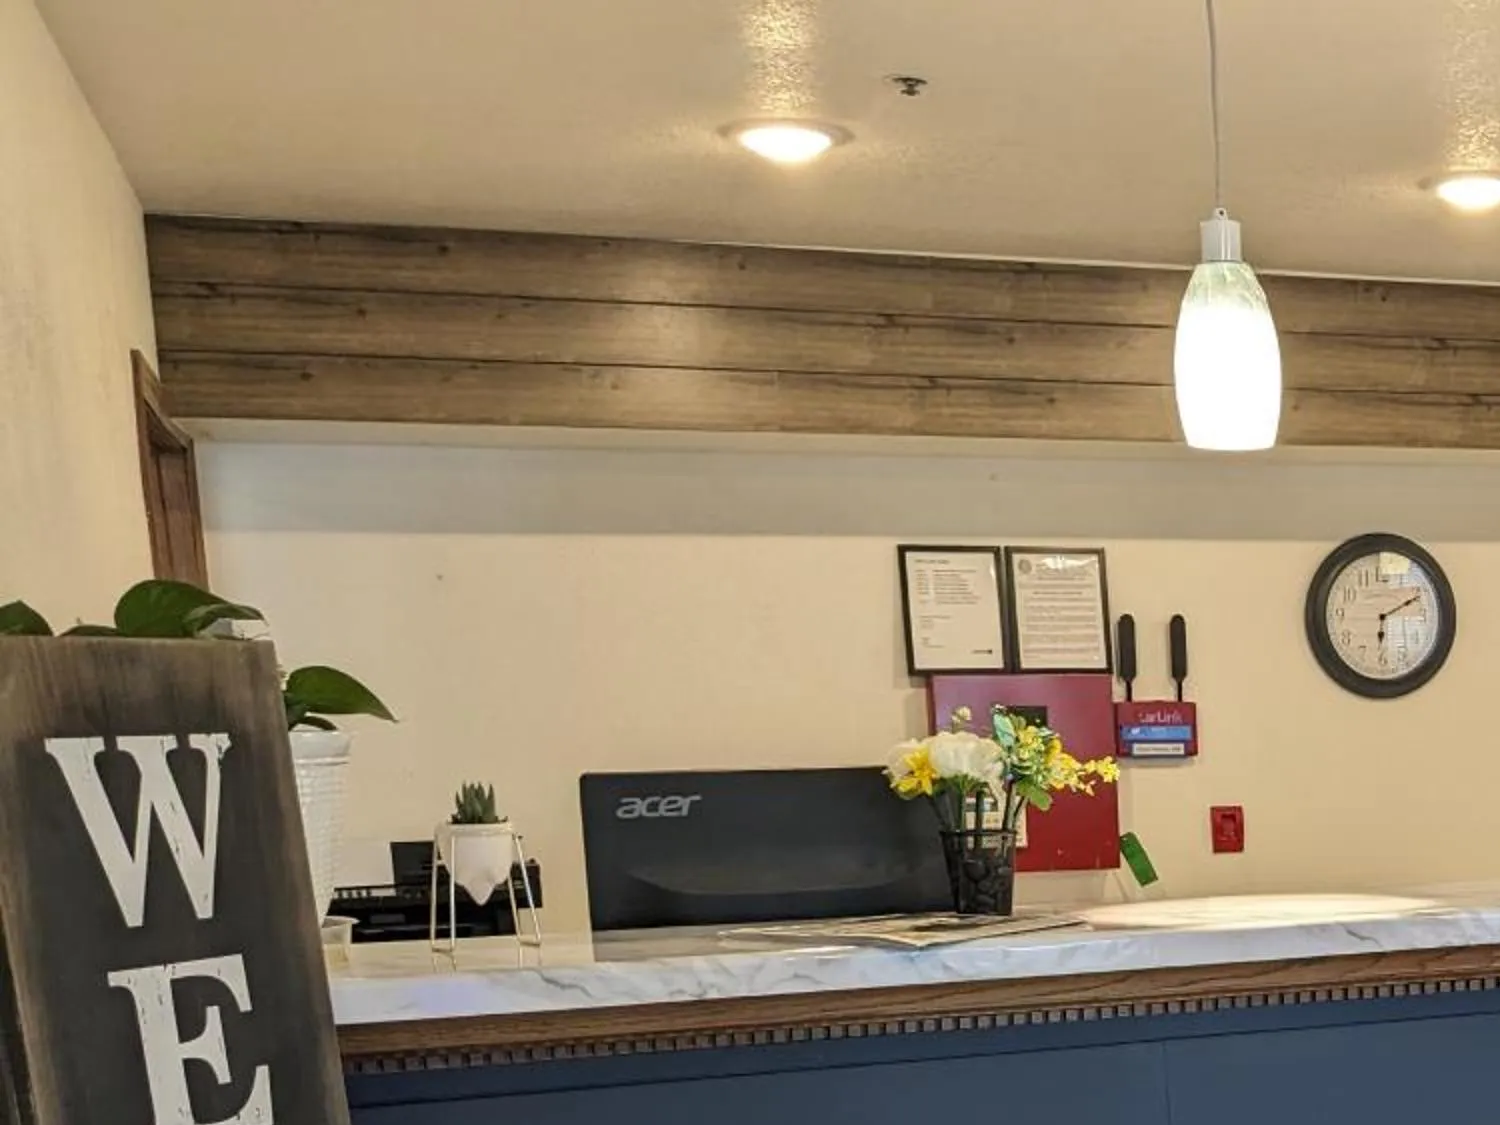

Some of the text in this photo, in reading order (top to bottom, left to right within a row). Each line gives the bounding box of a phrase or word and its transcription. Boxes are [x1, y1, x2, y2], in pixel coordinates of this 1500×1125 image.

[1357, 569, 1370, 587] 11
[1342, 588, 1357, 604] 10
[1335, 606, 1345, 623] 9
[1341, 630, 1351, 646] 8
[1357, 645, 1367, 661] 7
[1377, 648, 1388, 666] 6
[616, 794, 702, 819] acer
